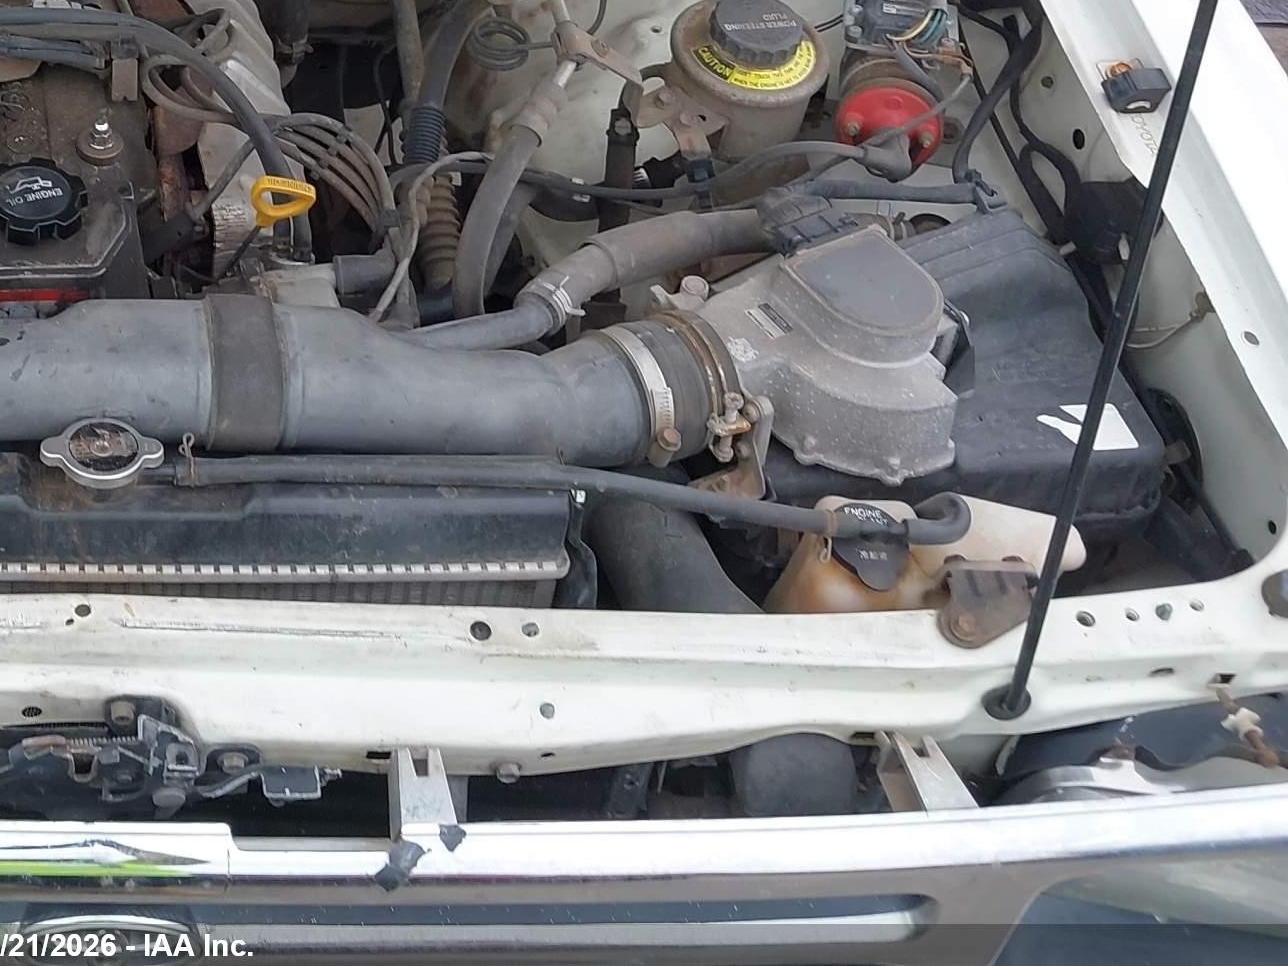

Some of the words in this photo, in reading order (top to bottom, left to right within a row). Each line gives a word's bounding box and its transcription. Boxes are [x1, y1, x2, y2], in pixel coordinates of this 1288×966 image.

[762, 12, 788, 21] FLUID
[724, 22, 765, 31] STEERING
[766, 19, 797, 29] POWER
[698, 47, 731, 77] CAUTION
[24, 187, 64, 202] ENGINE
[5, 195, 24, 207] OIL
[843, 506, 882, 519] ENGINE
